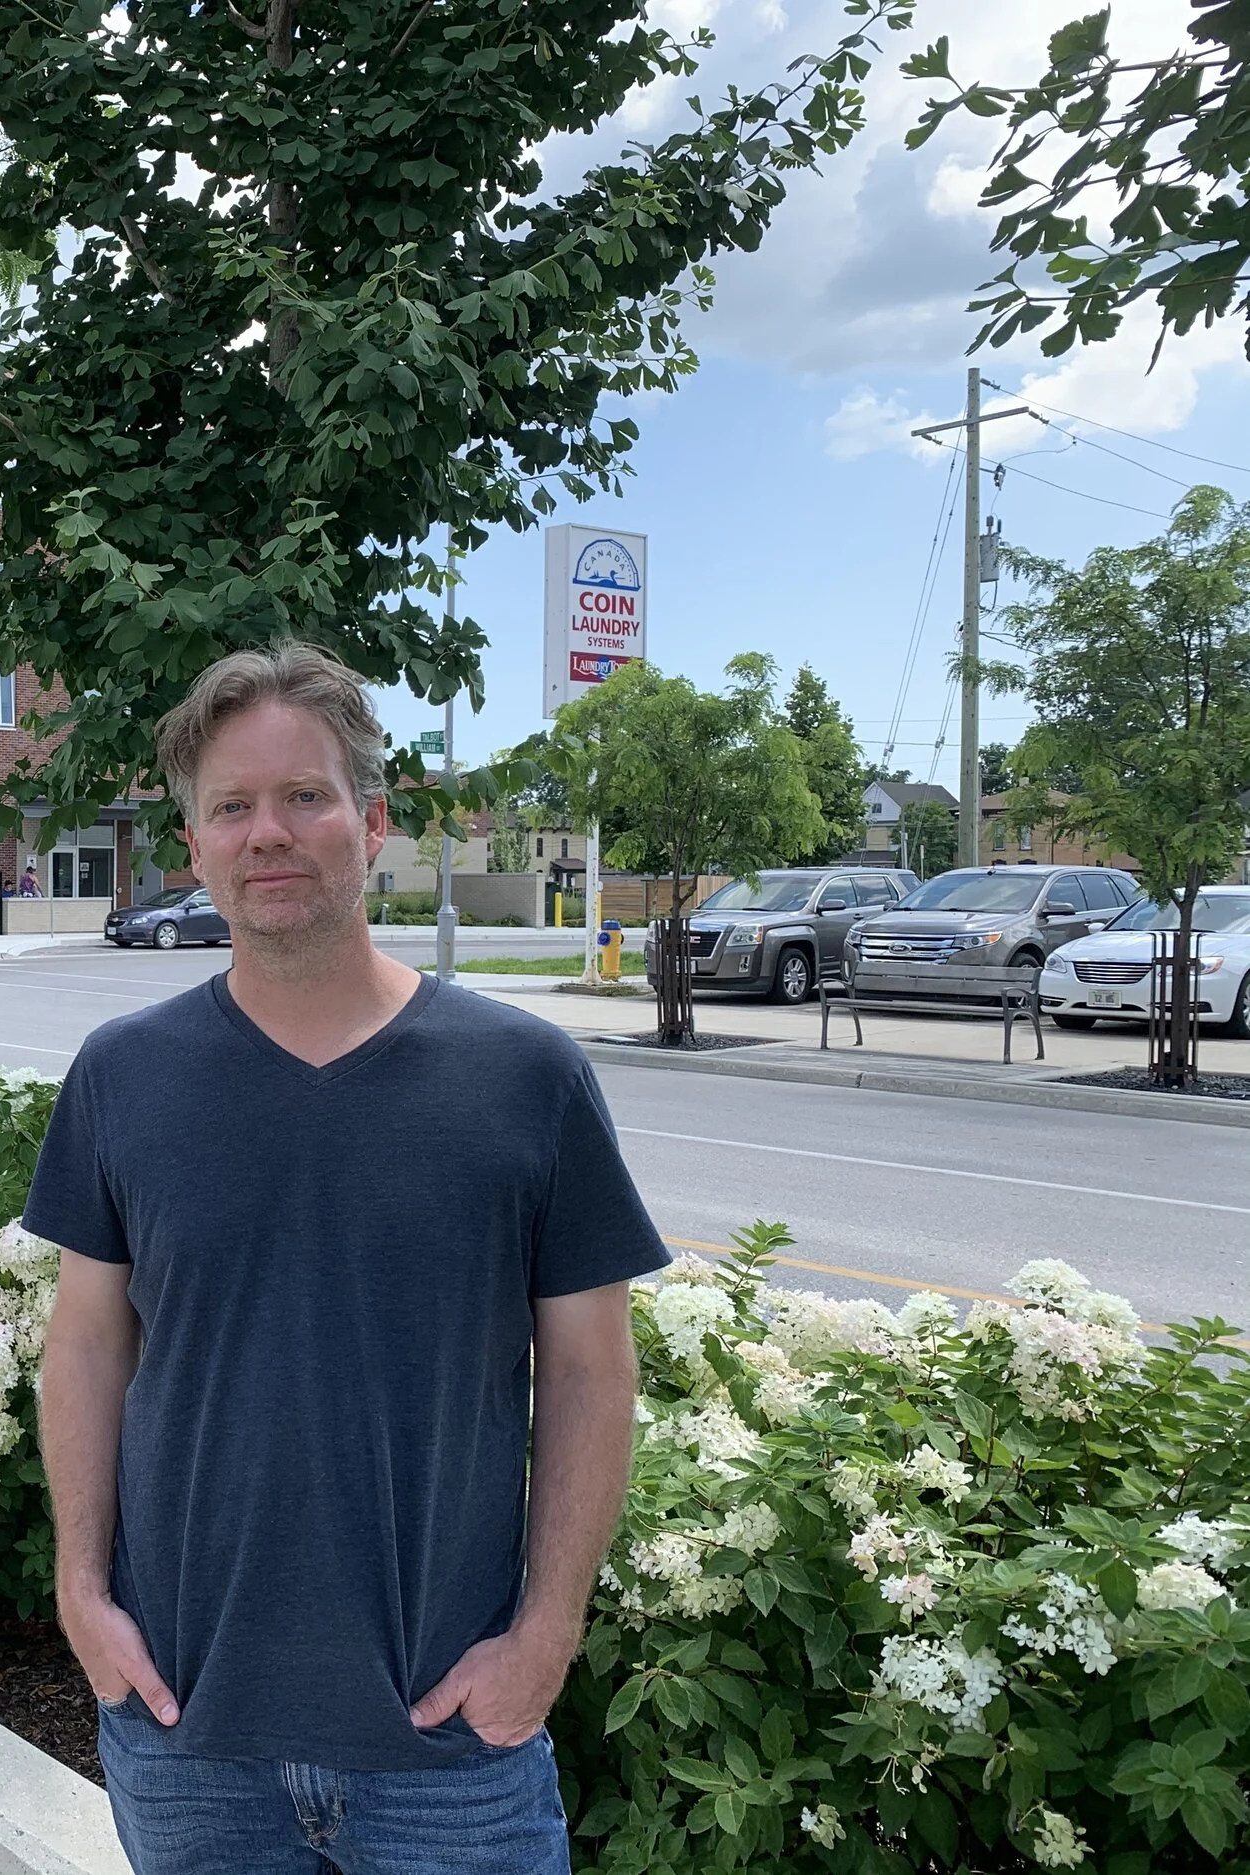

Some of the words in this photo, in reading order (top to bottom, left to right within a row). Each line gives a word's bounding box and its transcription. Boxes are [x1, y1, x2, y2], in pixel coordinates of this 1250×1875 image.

[584, 549, 625, 571] CANADA
[579, 591, 635, 616] COIN
[572, 615, 640, 637] LAUNDRY
[587, 636, 625, 650] SYSTEMS
[572, 656, 625, 673] LAUNDRYTO
